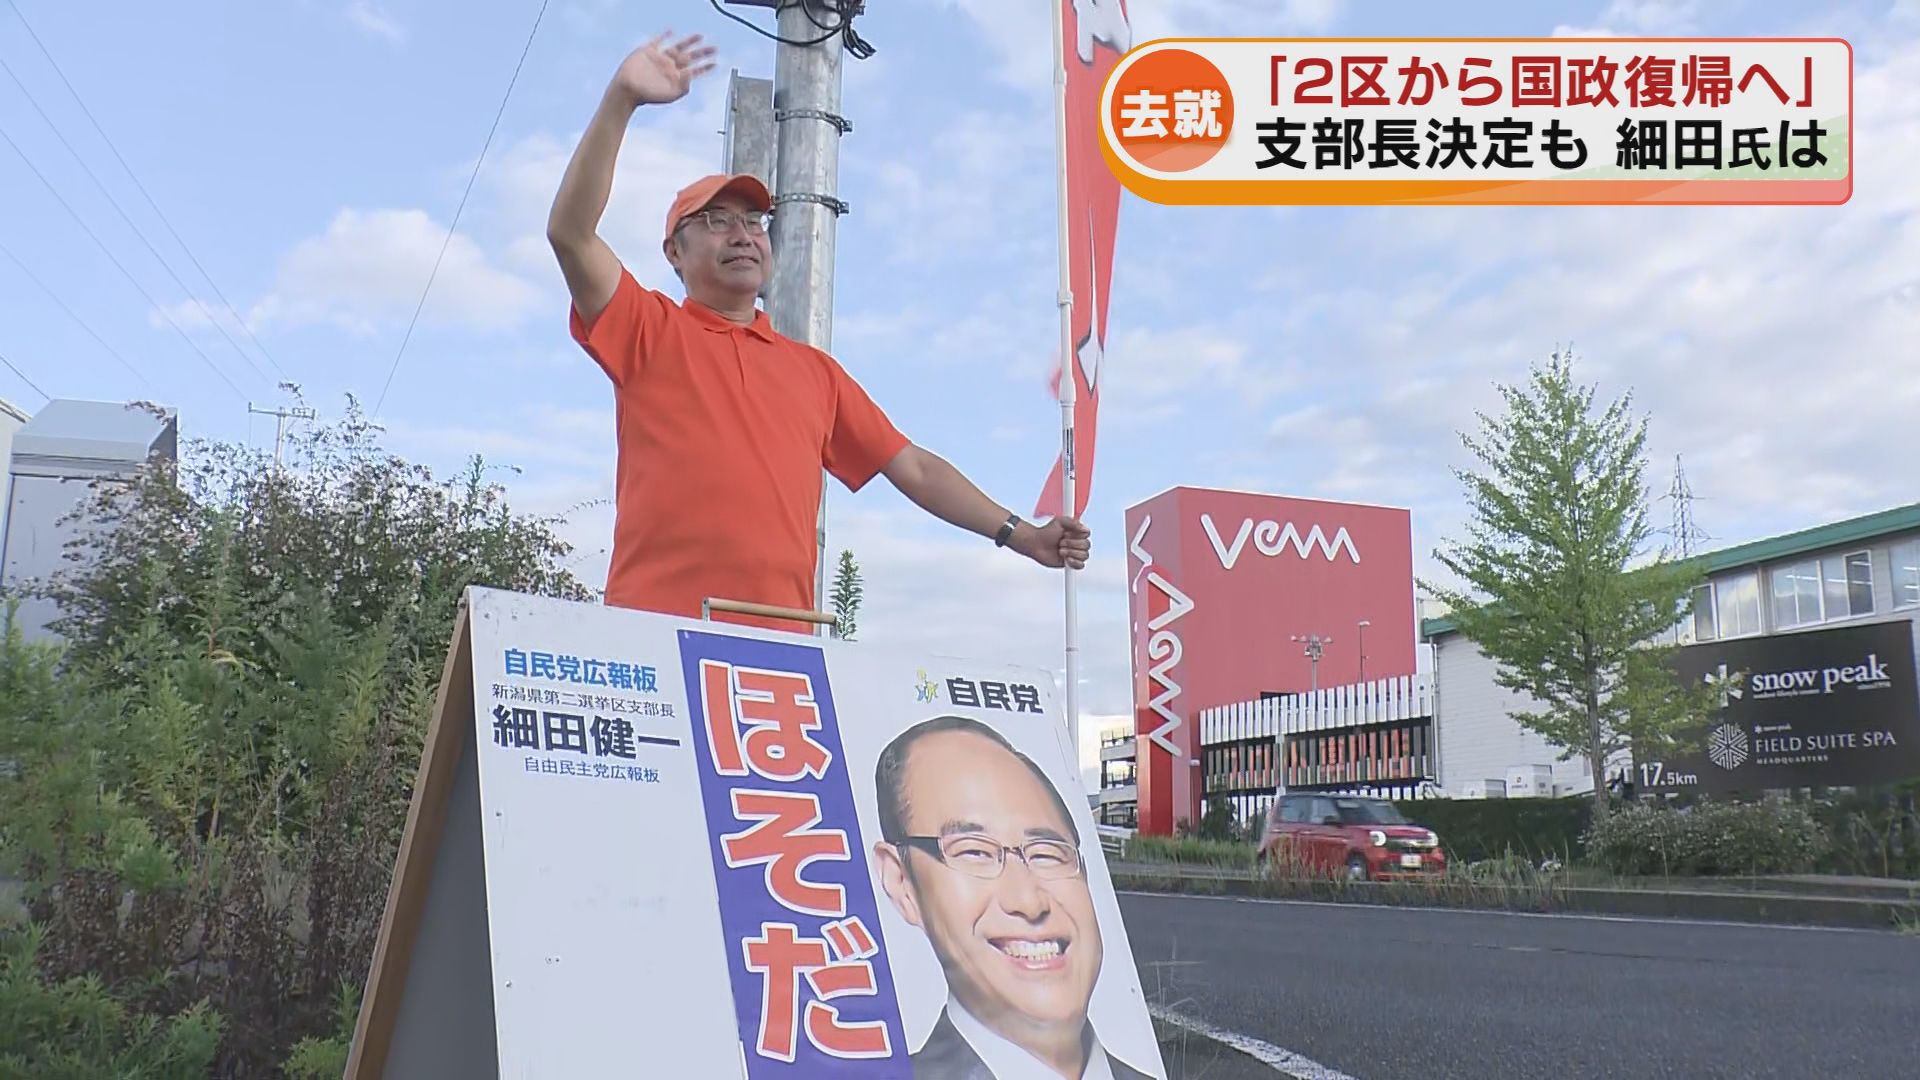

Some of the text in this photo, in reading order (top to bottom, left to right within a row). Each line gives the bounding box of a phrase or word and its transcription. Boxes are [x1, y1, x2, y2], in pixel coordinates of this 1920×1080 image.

[504, 648, 658, 693] 自民党広報板
[1752, 654, 1890, 693] snow peak
[492, 683, 676, 718] 新潟県第二選挙区支部長
[946, 677, 1044, 714] 自民党
[492, 704, 681, 759] 細田健一
[1755, 730, 1897, 753] FIELD SUITE SPA
[525, 756, 660, 783] 自由民主党広報板
[1640, 762, 1698, 787] 17.5km
[699, 657, 893, 1063] ほそだ
